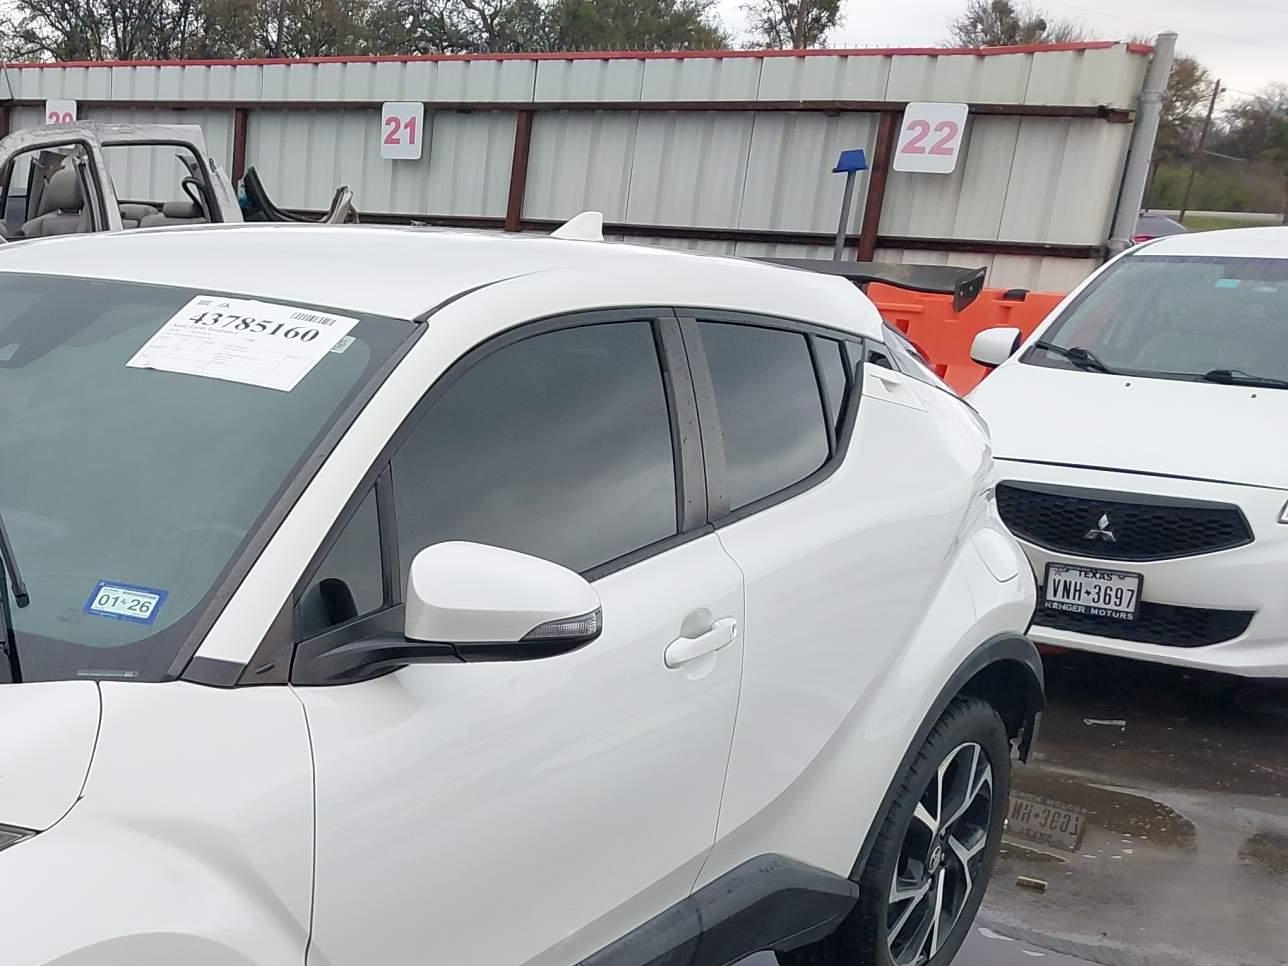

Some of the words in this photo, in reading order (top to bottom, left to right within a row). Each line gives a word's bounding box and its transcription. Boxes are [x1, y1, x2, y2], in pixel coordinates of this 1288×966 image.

[384, 116, 417, 145] 21
[901, 119, 959, 156] 22
[189, 311, 320, 343] 43785160
[1078, 570, 1113, 582] TEXAS
